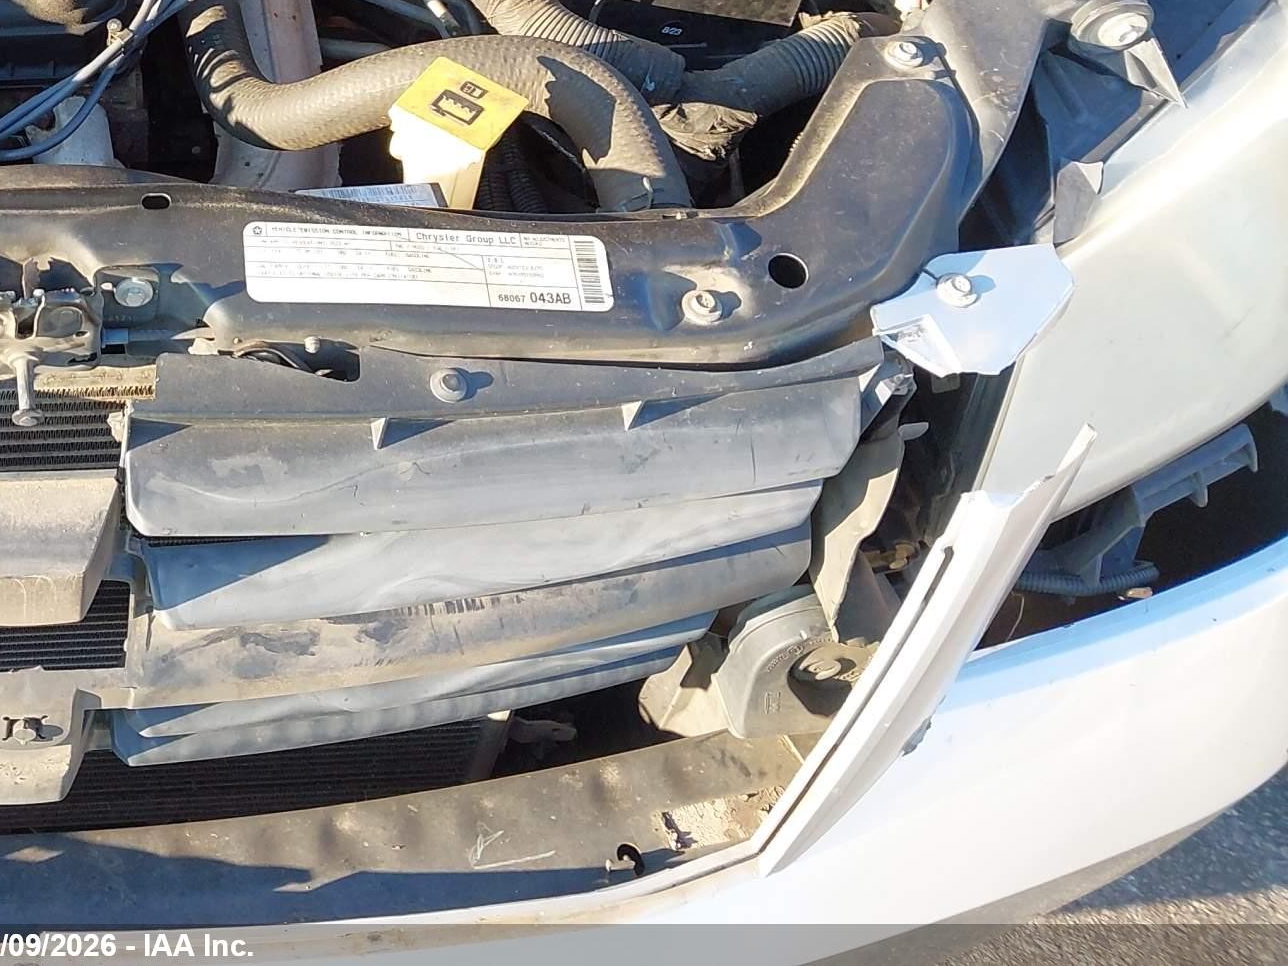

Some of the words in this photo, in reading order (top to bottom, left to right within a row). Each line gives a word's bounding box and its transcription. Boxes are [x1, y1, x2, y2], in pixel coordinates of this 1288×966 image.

[415, 232, 461, 246] Chrysler
[465, 234, 494, 247] Group
[497, 235, 517, 245] LLC
[497, 293, 526, 304] 68067
[529, 292, 572, 305] 043AB
